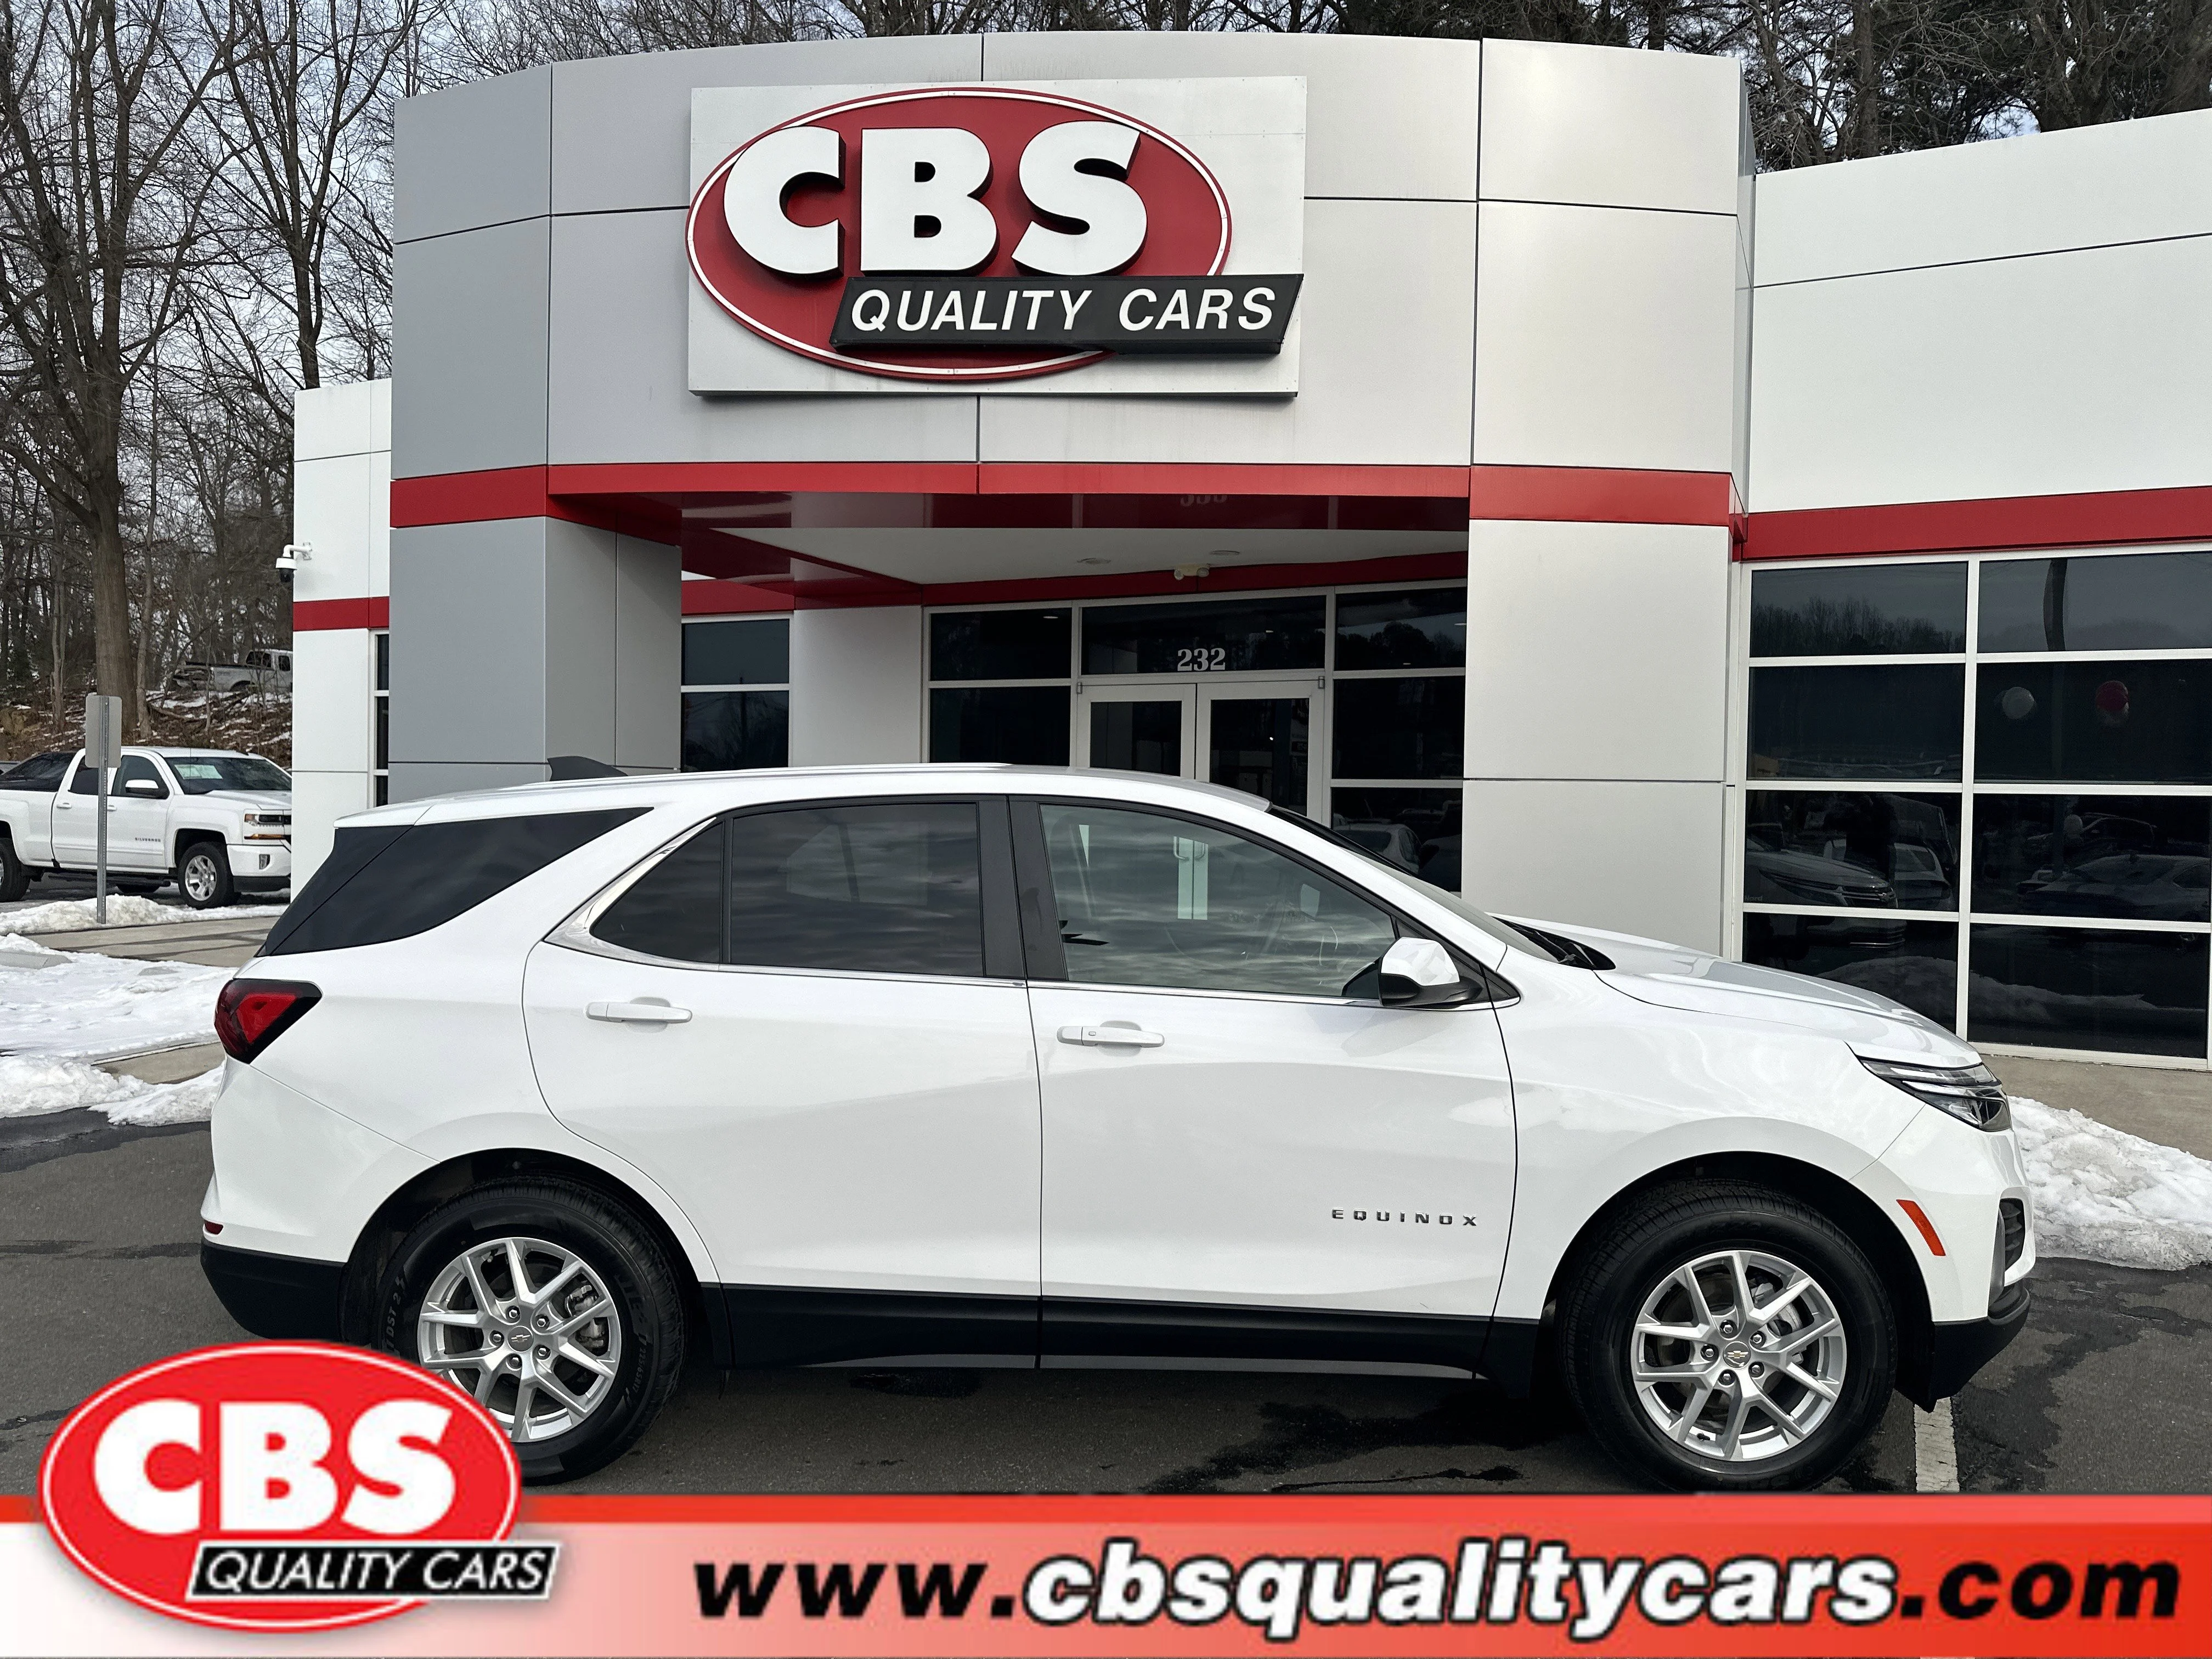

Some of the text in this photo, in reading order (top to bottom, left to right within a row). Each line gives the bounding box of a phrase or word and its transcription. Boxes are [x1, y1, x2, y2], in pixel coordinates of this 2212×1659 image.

[723, 120, 1149, 277] CBS
[850, 286, 1277, 333] QUALITY CARS
[1177, 647, 1226, 672] 232
[1331, 1208, 1477, 1226] EQUINOX
